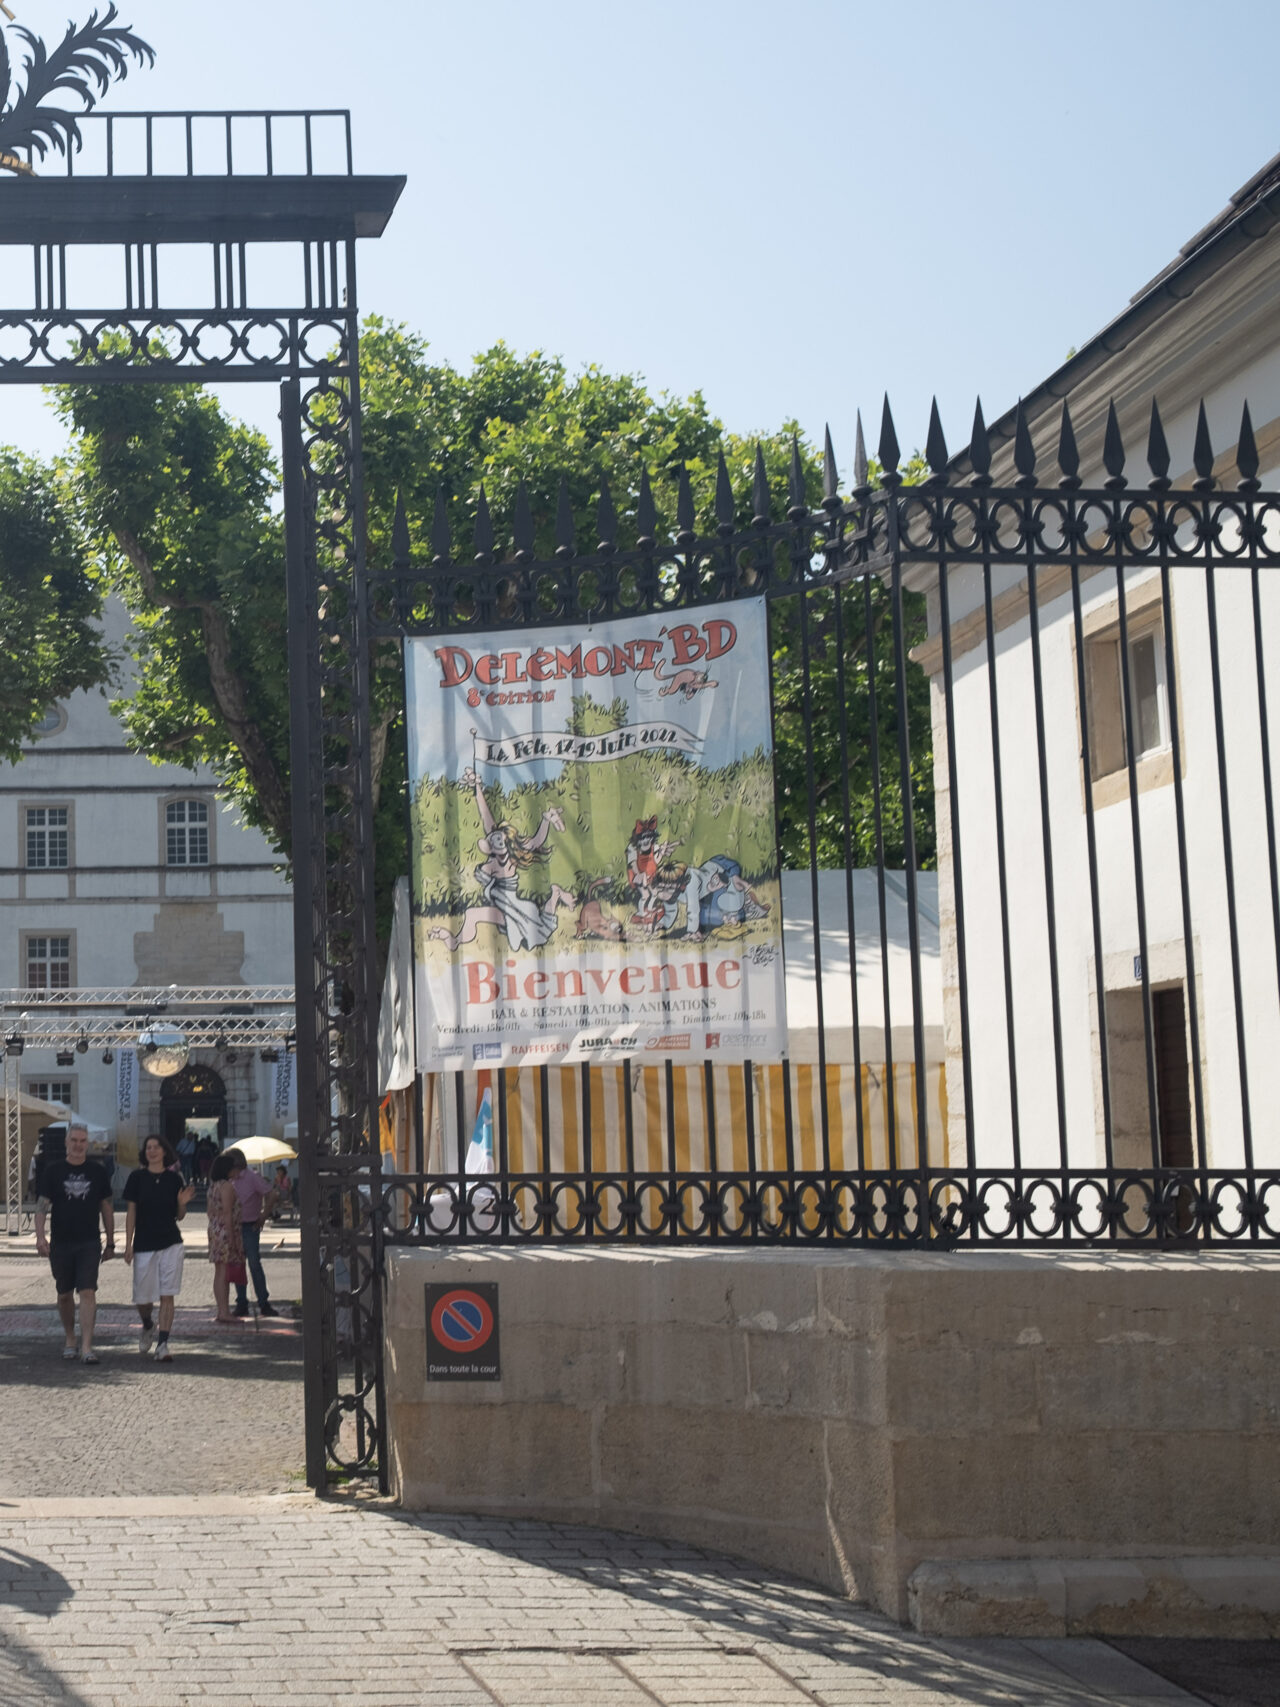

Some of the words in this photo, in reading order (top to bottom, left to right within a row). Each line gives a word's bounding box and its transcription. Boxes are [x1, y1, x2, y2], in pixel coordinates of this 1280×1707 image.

[640, 728, 678, 744] 2022
[462, 959, 741, 1005] Bienvenue
[491, 1008, 516, 1019] BAR
[521, 1008, 528, 1018] &
[638, 998, 717, 1014] ANIMATIONS
[512, 1043, 568, 1054] RAIFFEISEN
[579, 1037, 612, 1048] JURA
[429, 1364, 448, 1373] Dans
[450, 1365, 469, 1373] toute
[471, 1364, 479, 1373] la
